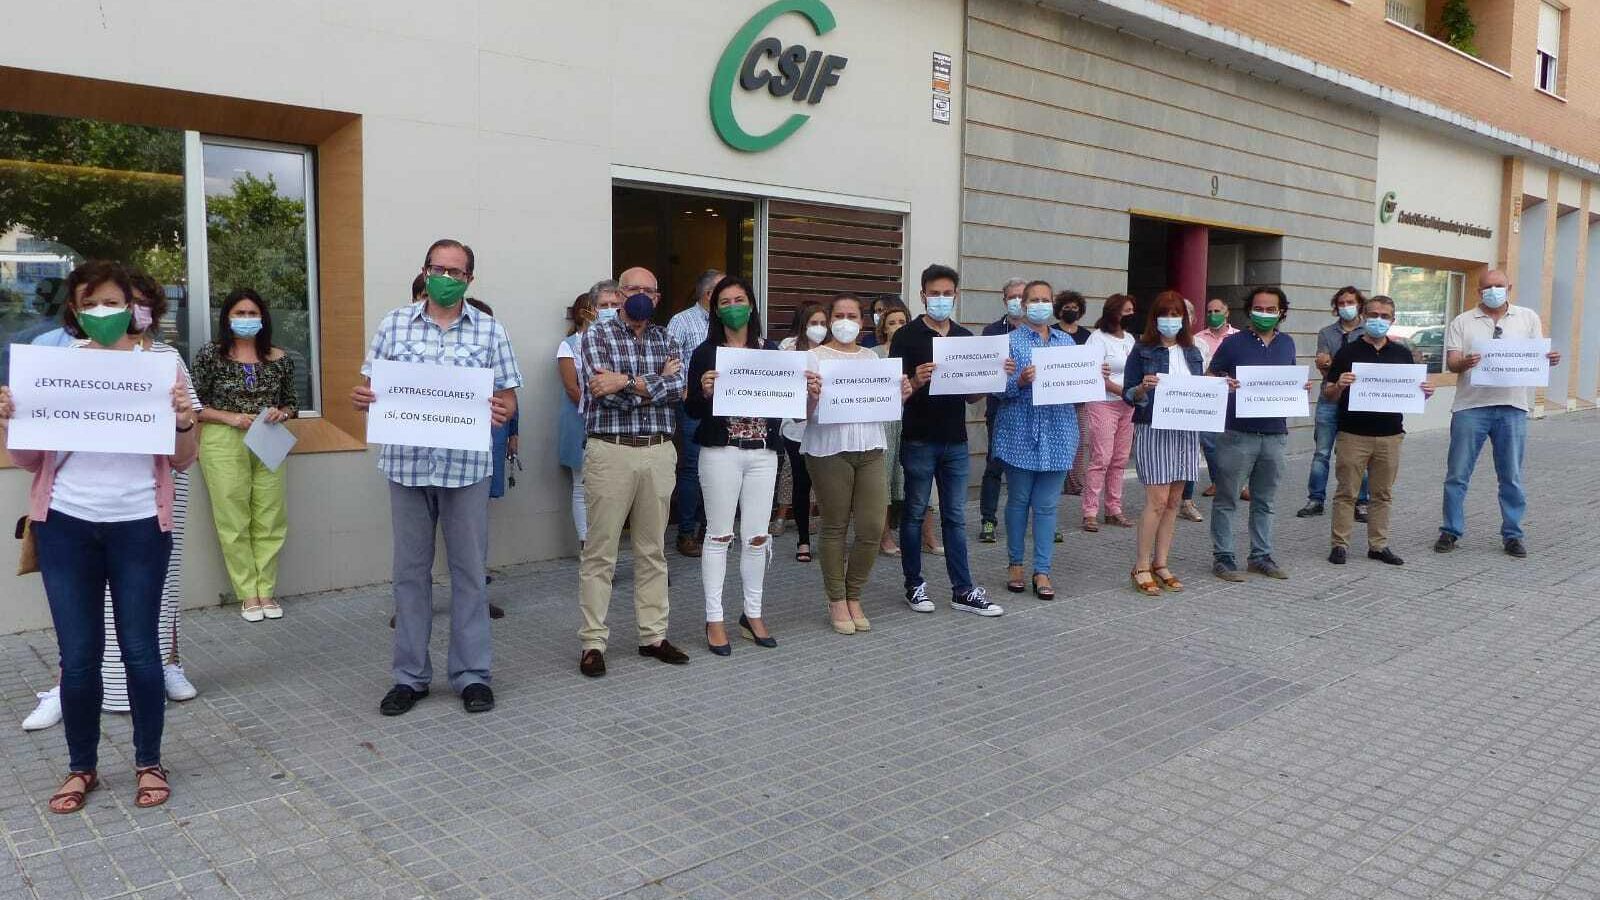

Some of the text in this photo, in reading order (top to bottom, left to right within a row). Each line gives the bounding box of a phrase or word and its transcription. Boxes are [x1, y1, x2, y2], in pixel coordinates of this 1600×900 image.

[740, 37, 848, 105] CSIF
[1211, 175, 1219, 197] 9
[729, 368, 795, 377] ¿EXTRAESCOLARES?
[35, 377, 153, 392] ¿EXTRAESCOLARES?
[832, 377, 891, 385] ¿EXTRAESCOLARES?
[388, 386, 475, 400] ¿EXTRAESCOLARES?
[753, 390, 795, 398] SEGURIDAD!
[31, 407, 156, 423] ¡SÍ, CON SEGURIDAD!
[384, 410, 476, 425] ¡SÍ, CON SEGURIDAD!
